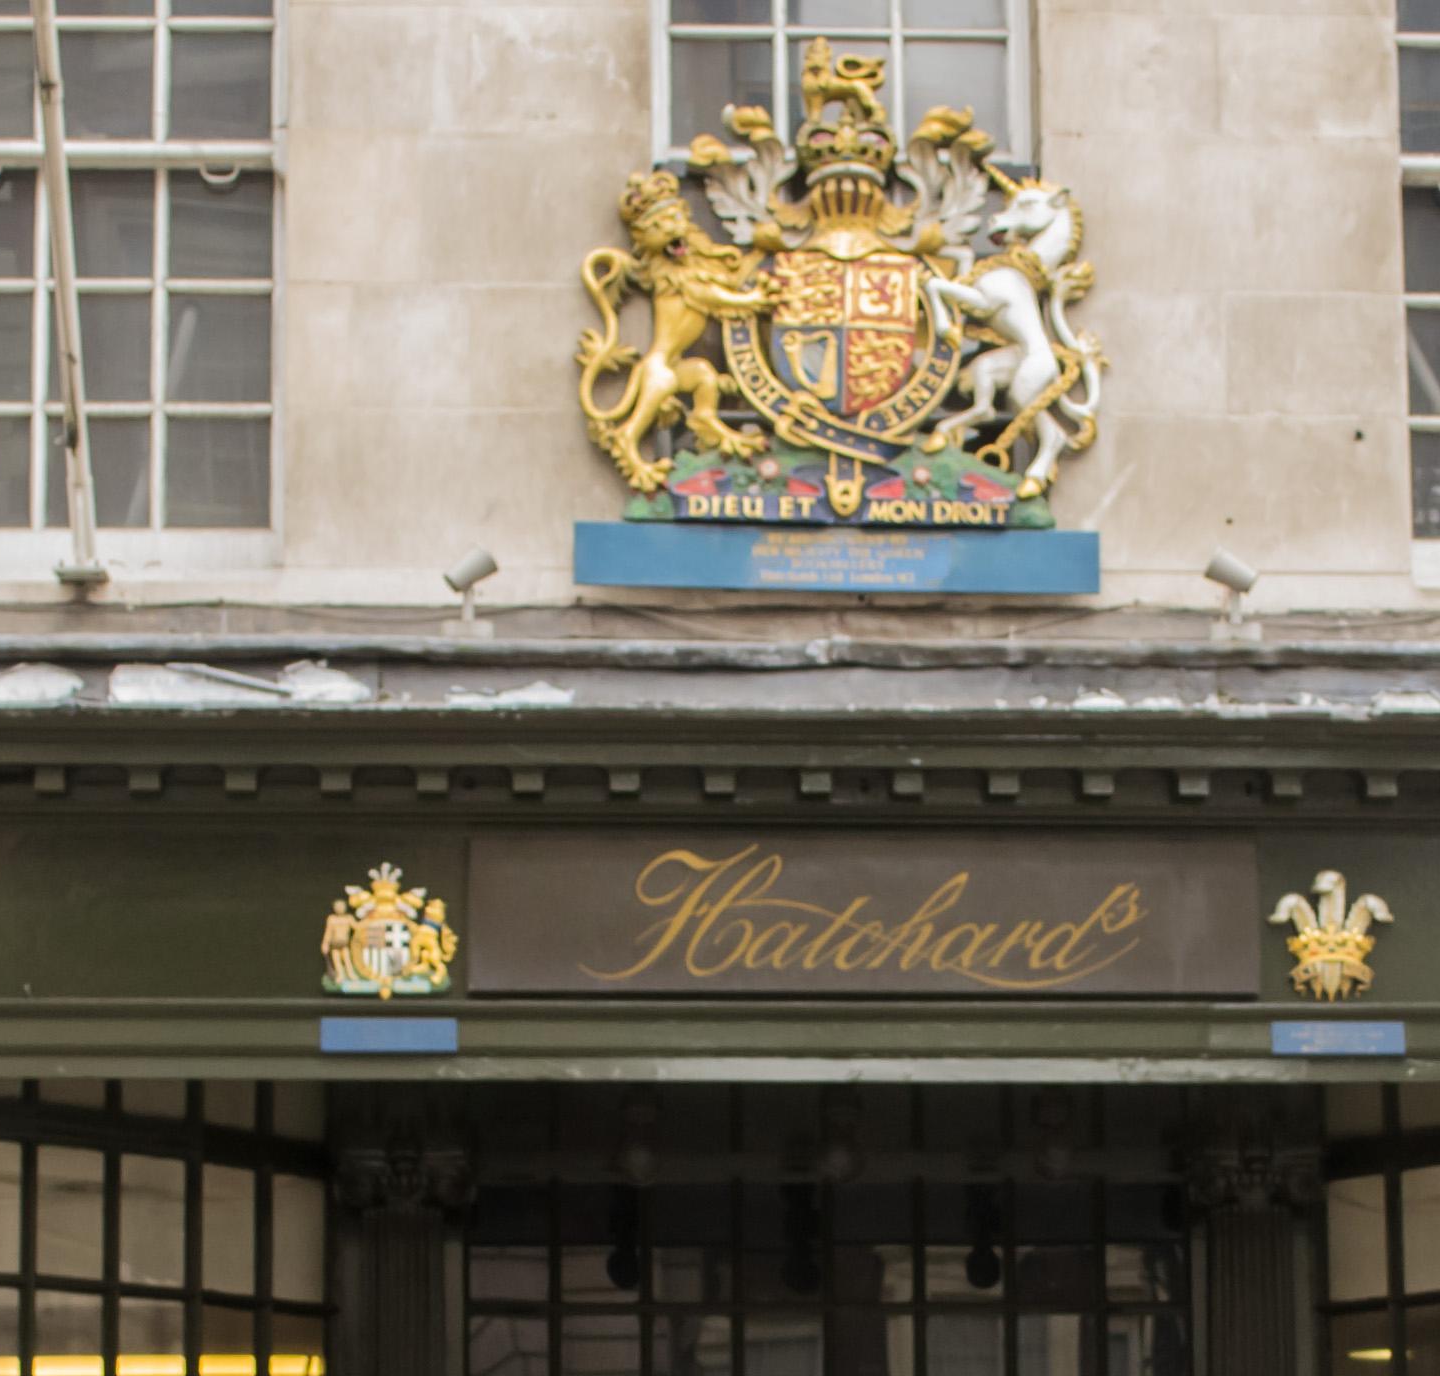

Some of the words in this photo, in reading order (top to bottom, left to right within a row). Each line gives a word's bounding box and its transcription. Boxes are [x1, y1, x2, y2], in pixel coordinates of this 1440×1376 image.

[733, 346, 781, 406] HONI
[882, 356, 949, 429] PENSE
[687, 493, 763, 519] DIEU
[778, 495, 817, 519] ET
[866, 500, 926, 523] MON
[932, 501, 1010, 525] DROIT
